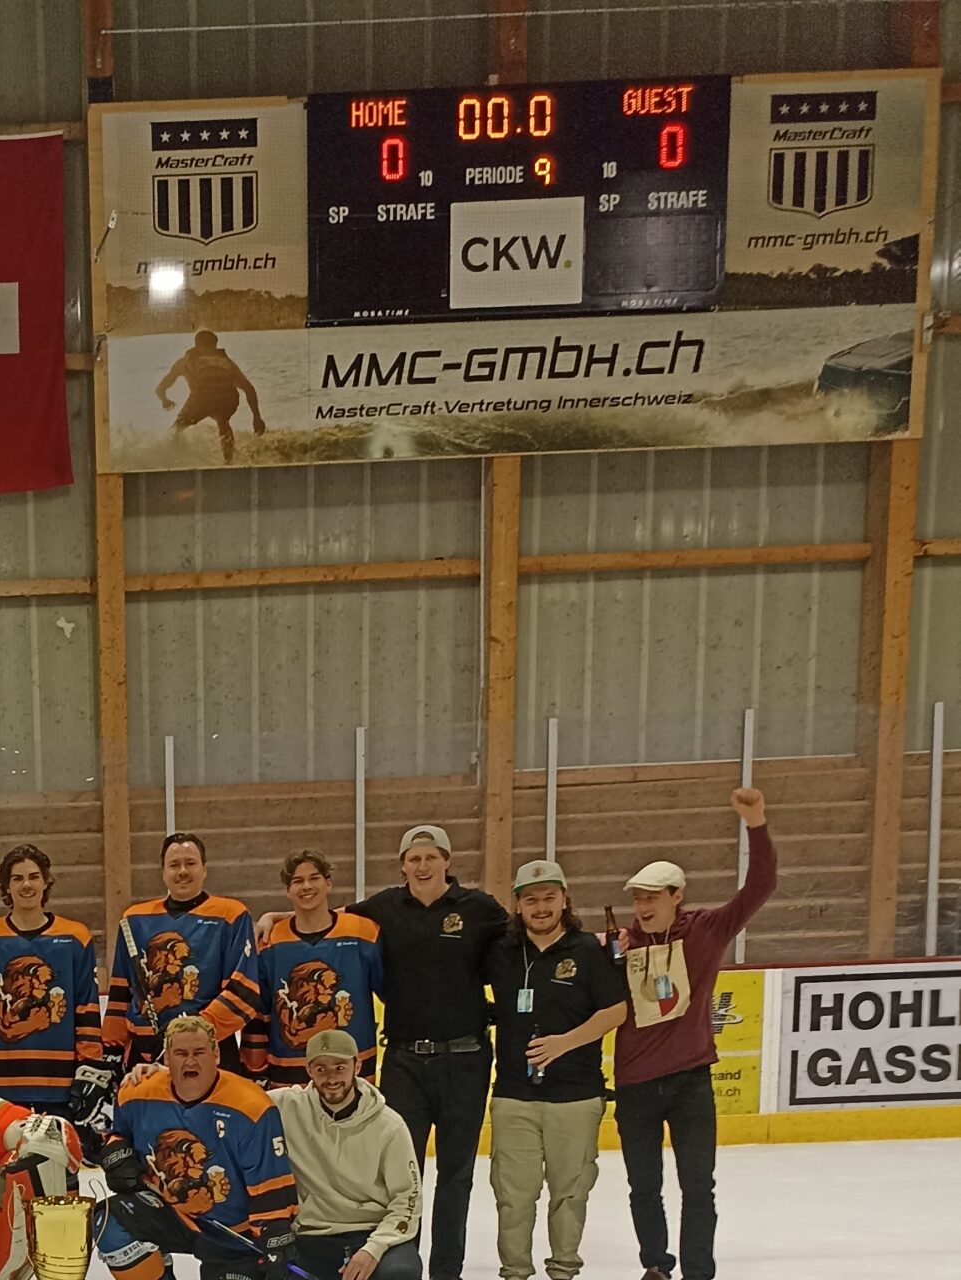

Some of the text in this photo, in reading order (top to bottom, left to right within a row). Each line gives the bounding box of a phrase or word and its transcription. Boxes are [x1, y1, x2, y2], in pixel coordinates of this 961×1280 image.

[623, 86, 694, 115] GUEST
[350, 100, 407, 128] HOME
[458, 96, 551, 140] 00.0
[772, 126, 872, 143] MasterCraft
[659, 126, 684, 168] 0
[155, 153, 254, 170] MasterCraft
[382, 138, 404, 180] 0
[601, 161, 617, 179] 10
[418, 170, 433, 187] 10
[465, 165, 524, 186] PERIODE
[598, 190, 707, 213] SP STRAFE
[328, 203, 436, 224] SP STRAFE
[747, 225, 889, 251] mmc-gmbh.ch
[353, 309, 410, 318] MOBATIME
[315, 390, 694, 419] MasterCraft-Vertretung Innerschweiz
